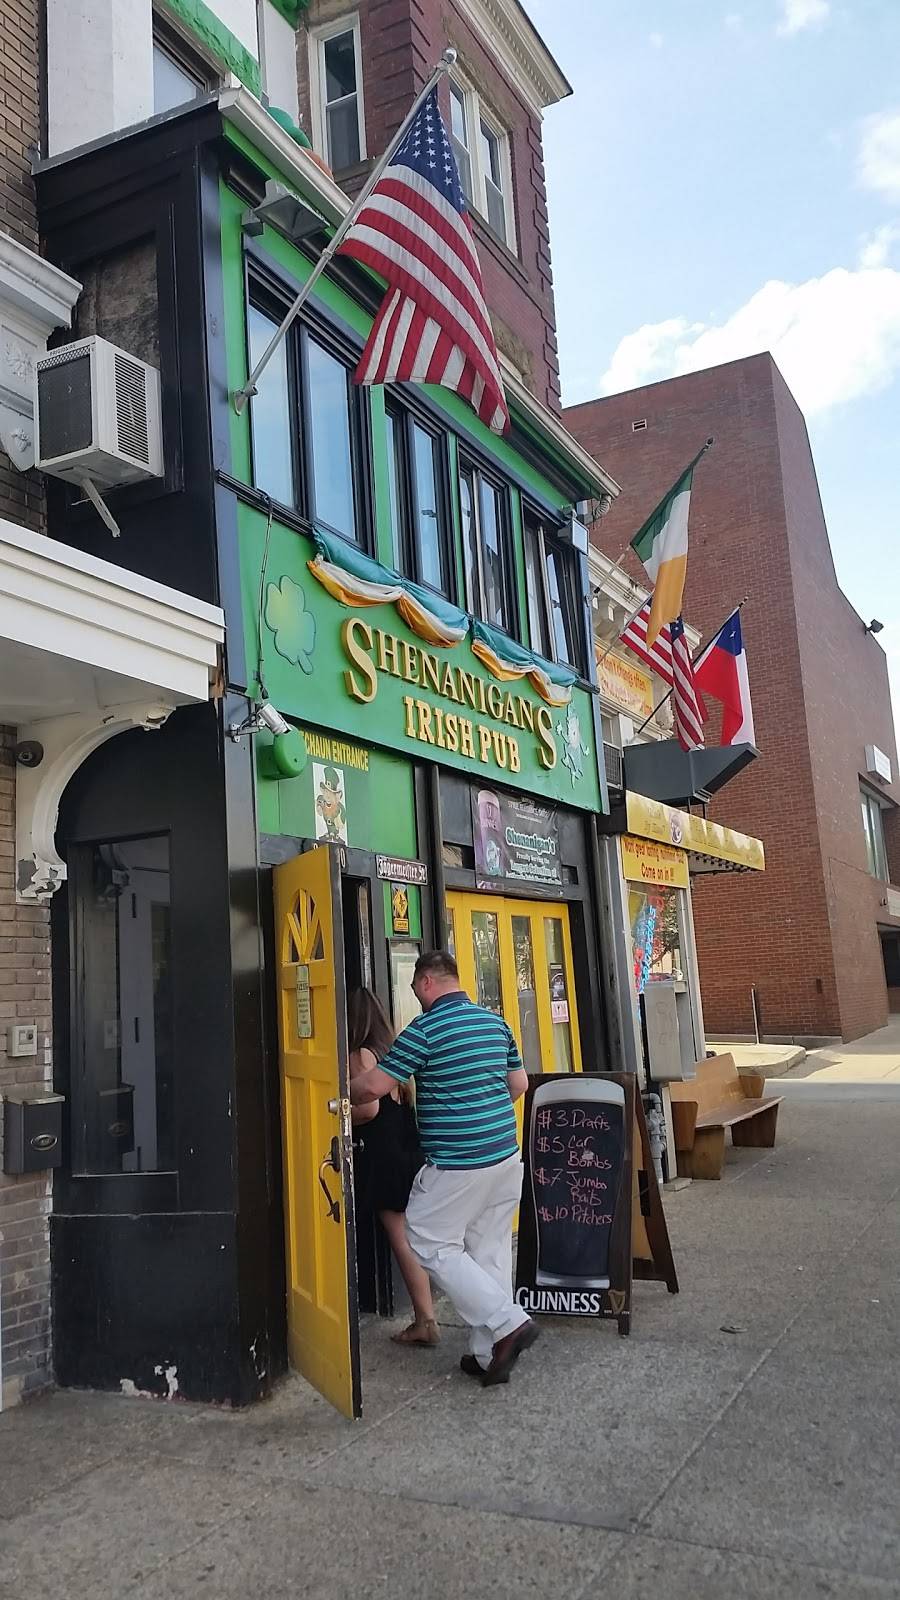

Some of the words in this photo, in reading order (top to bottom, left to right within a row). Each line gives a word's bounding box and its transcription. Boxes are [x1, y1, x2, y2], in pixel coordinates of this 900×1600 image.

[341, 616, 557, 770] SHENANIGANS
[403, 695, 476, 759] IRISH
[478, 723, 521, 773] PUB
[332, 740, 369, 772] ENTRANCE
[505, 826, 556, 855] Shenanigan's
[641, 862, 656, 879] Come
[657, 868, 663, 880] on
[664, 866, 669, 880] in
[570, 1109, 611, 1131] Drafts
[536, 1137, 567, 1155] $5
[568, 1134, 594, 1149] Car
[567, 1151, 612, 1169] Bombs
[535, 1167, 564, 1187] $7
[566, 1171, 608, 1190] Jumbo
[538, 1205, 569, 1223] $10
[571, 1204, 613, 1225] Pitchers
[515, 1286, 601, 1313] GUINNESS
